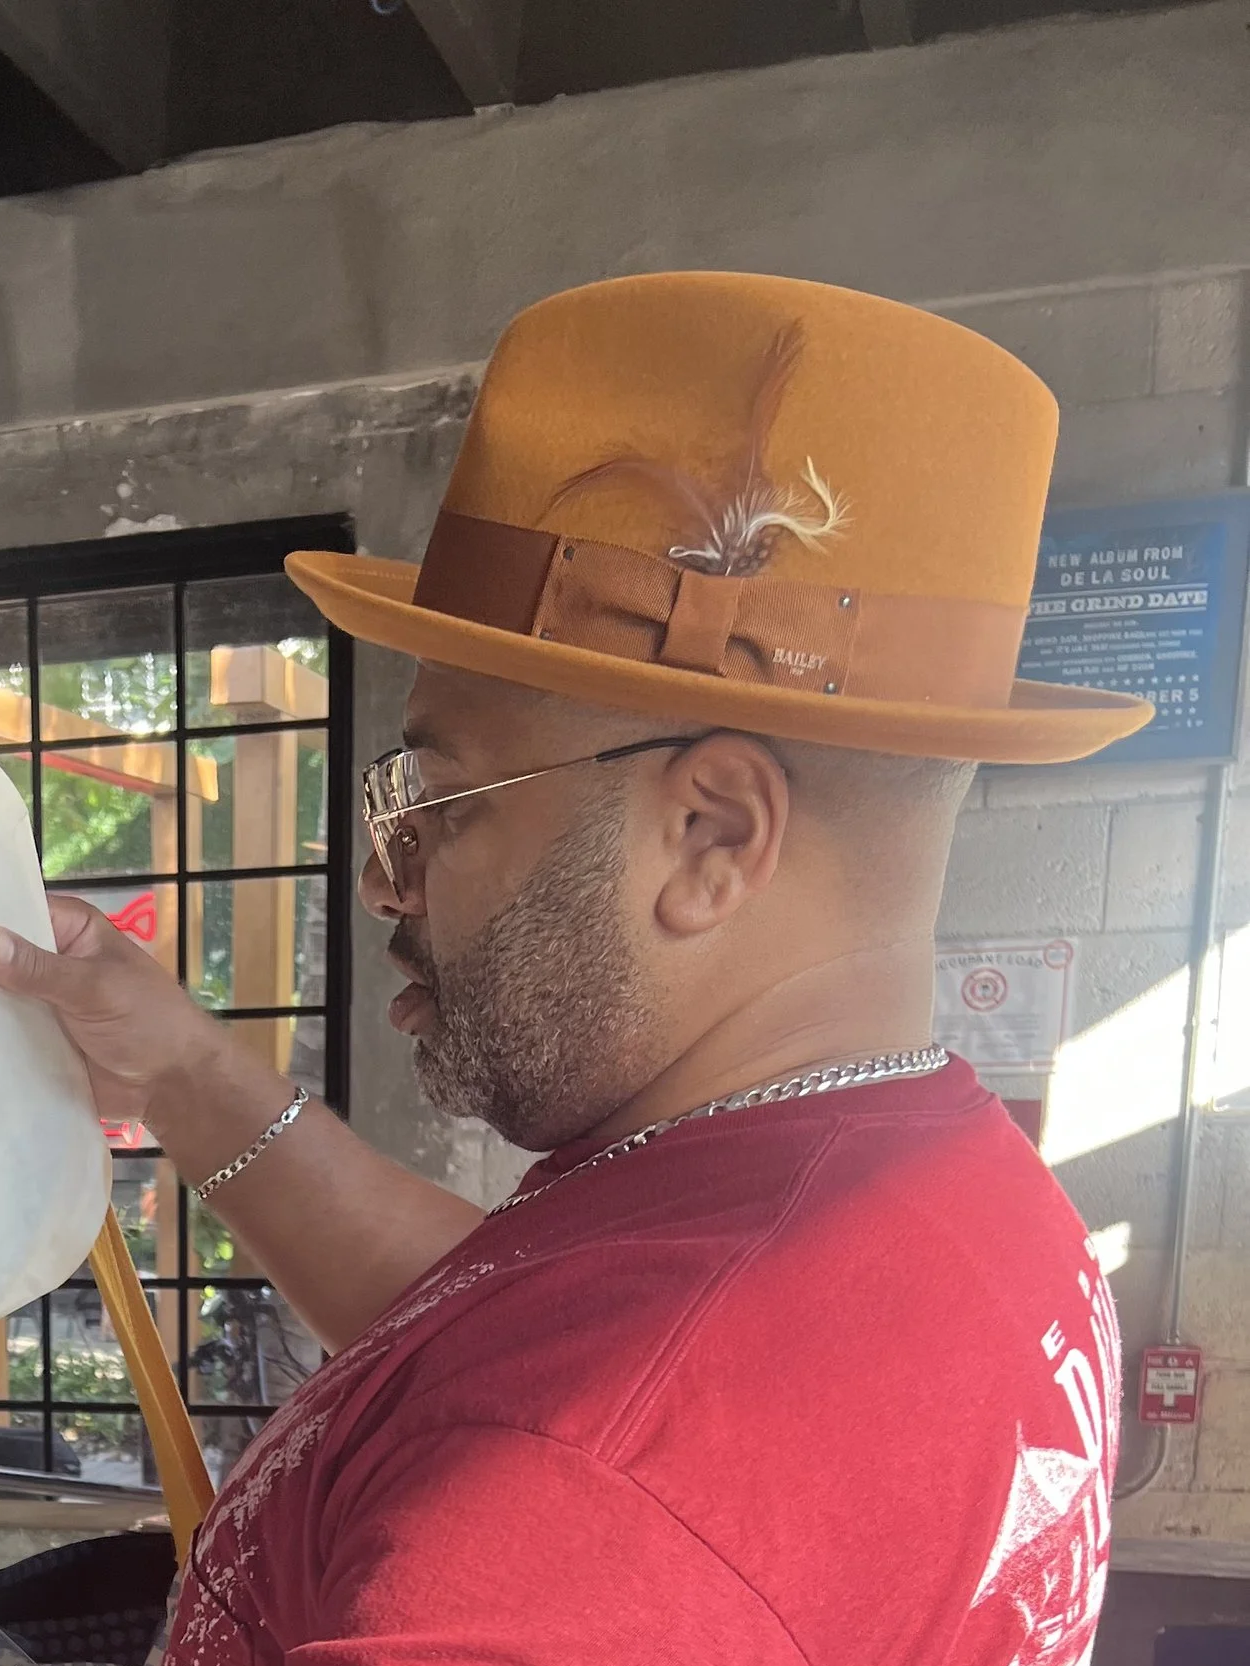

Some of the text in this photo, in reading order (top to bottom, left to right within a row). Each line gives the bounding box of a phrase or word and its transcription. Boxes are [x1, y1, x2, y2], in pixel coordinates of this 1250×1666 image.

[1048, 546, 1183, 568] NEW ALBUM FROM
[1060, 566, 1171, 587] DE LA SOUL
[1070, 595, 1144, 613] GRIND
[1147, 590, 1208, 608] DATE
[1190, 687, 1200, 701] 5
